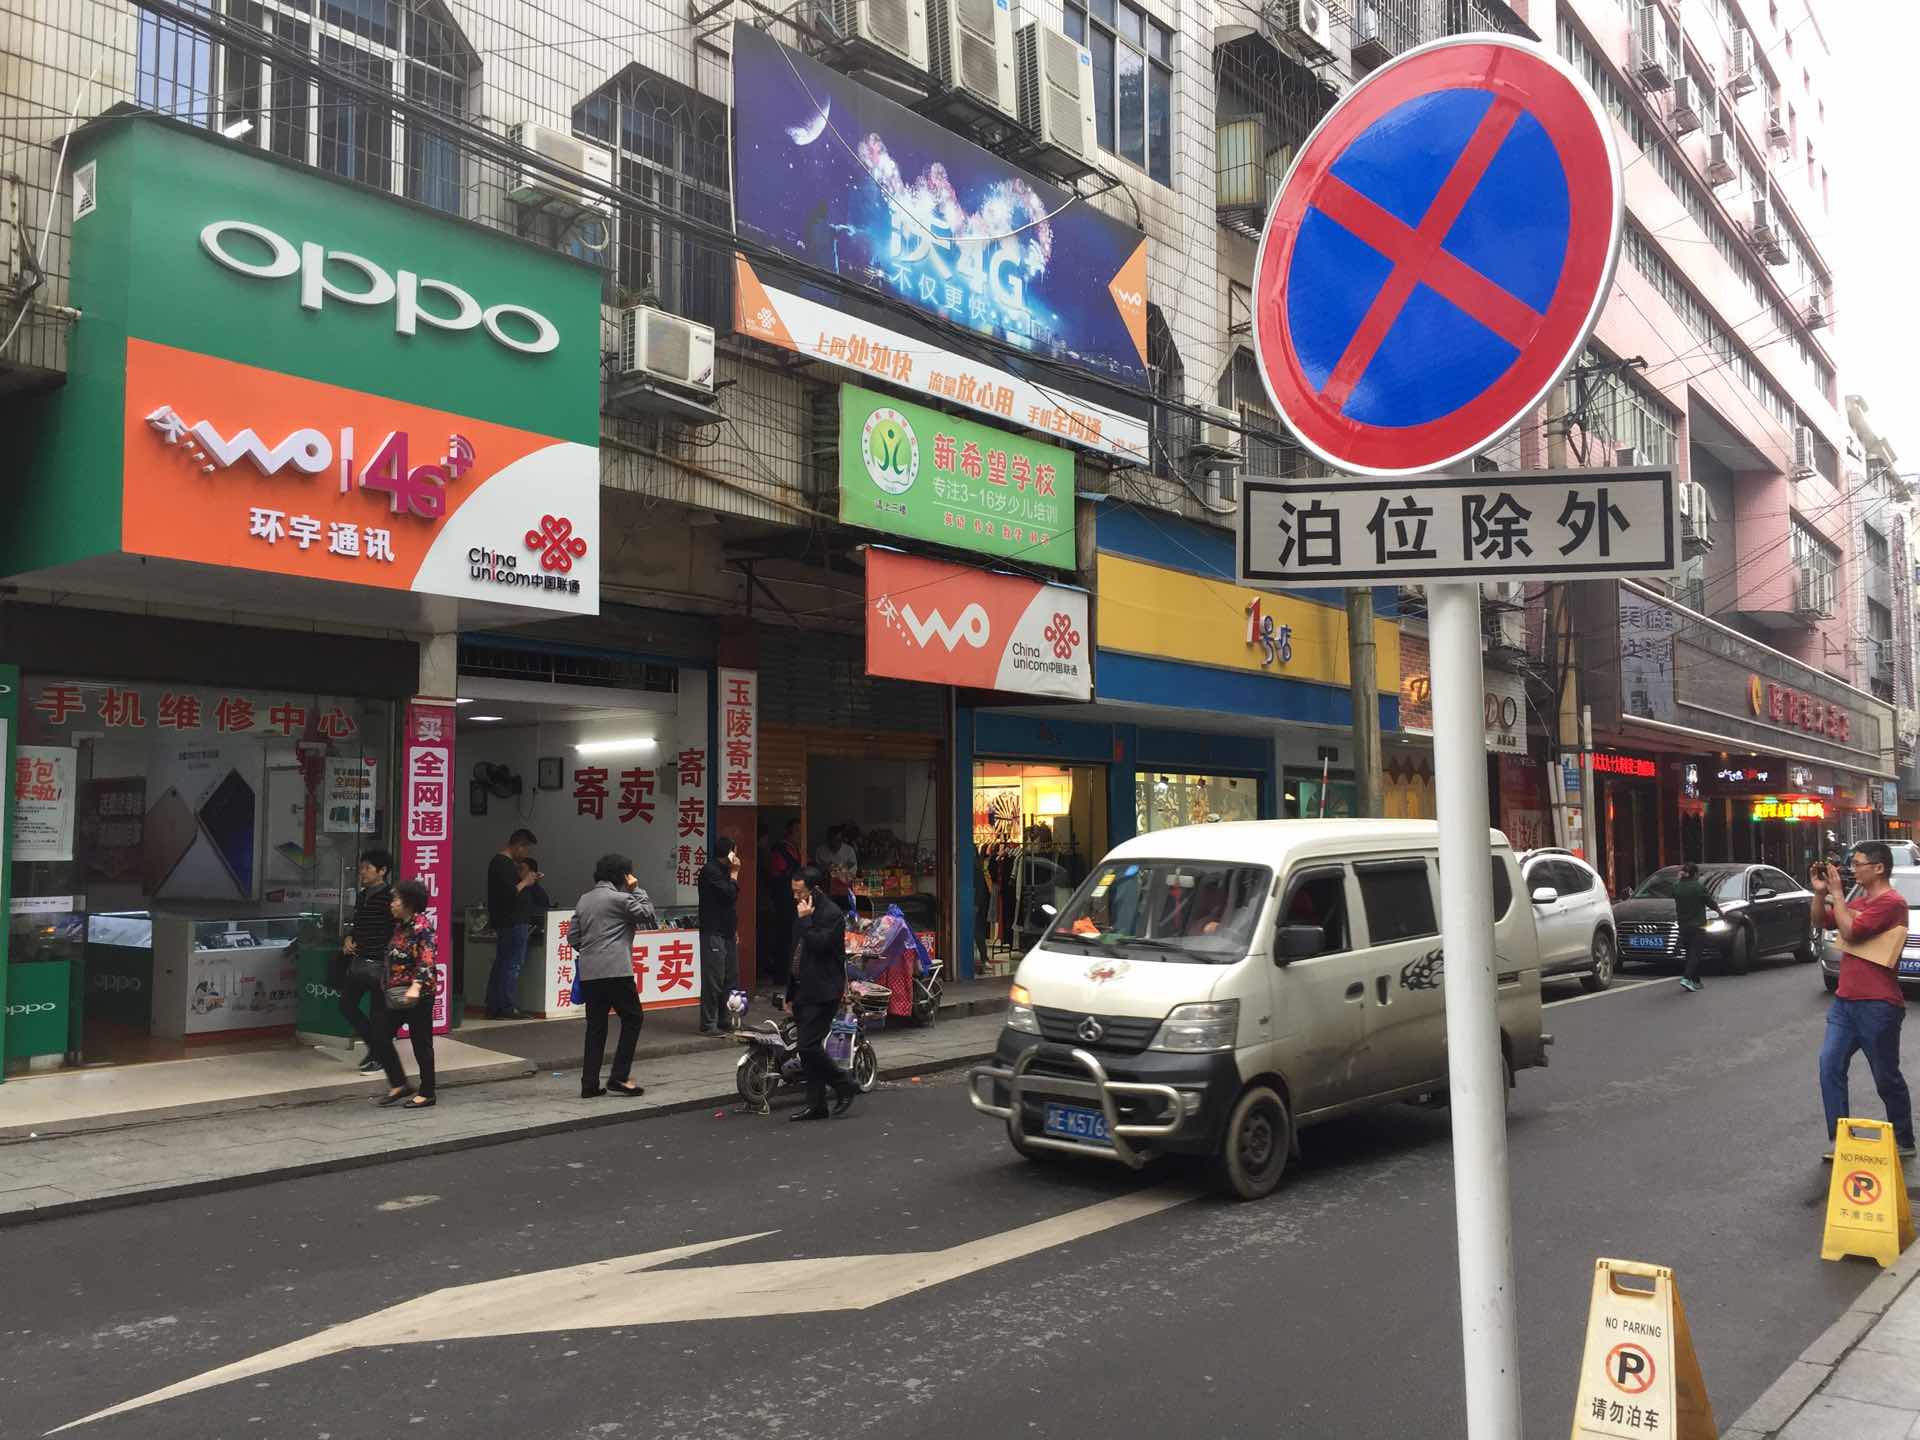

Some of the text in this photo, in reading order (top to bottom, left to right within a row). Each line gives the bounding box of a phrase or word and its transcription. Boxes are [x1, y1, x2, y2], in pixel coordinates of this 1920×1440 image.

[889, 262, 988, 322] 不仅更快
[932, 431, 1057, 498] 新希望学校
[249, 506, 396, 562] 环宇通讯
[1277, 487, 1632, 567] 泊位除外
[468, 546, 518, 568] China
[470, 564, 581, 594] unicom 中国联通
[1012, 641, 1041, 658] China
[1013, 658, 1079, 676] unicom 中国联通
[33, 686, 359, 738] 手机维修中心
[573, 766, 656, 824] 寄卖
[678, 748, 706, 838] 寄卖
[1840, 1153, 1888, 1166] NO PARKING
[1605, 1316, 1662, 1338] NO PARKING
[1591, 1397, 1660, 1432] 请勿泊车
